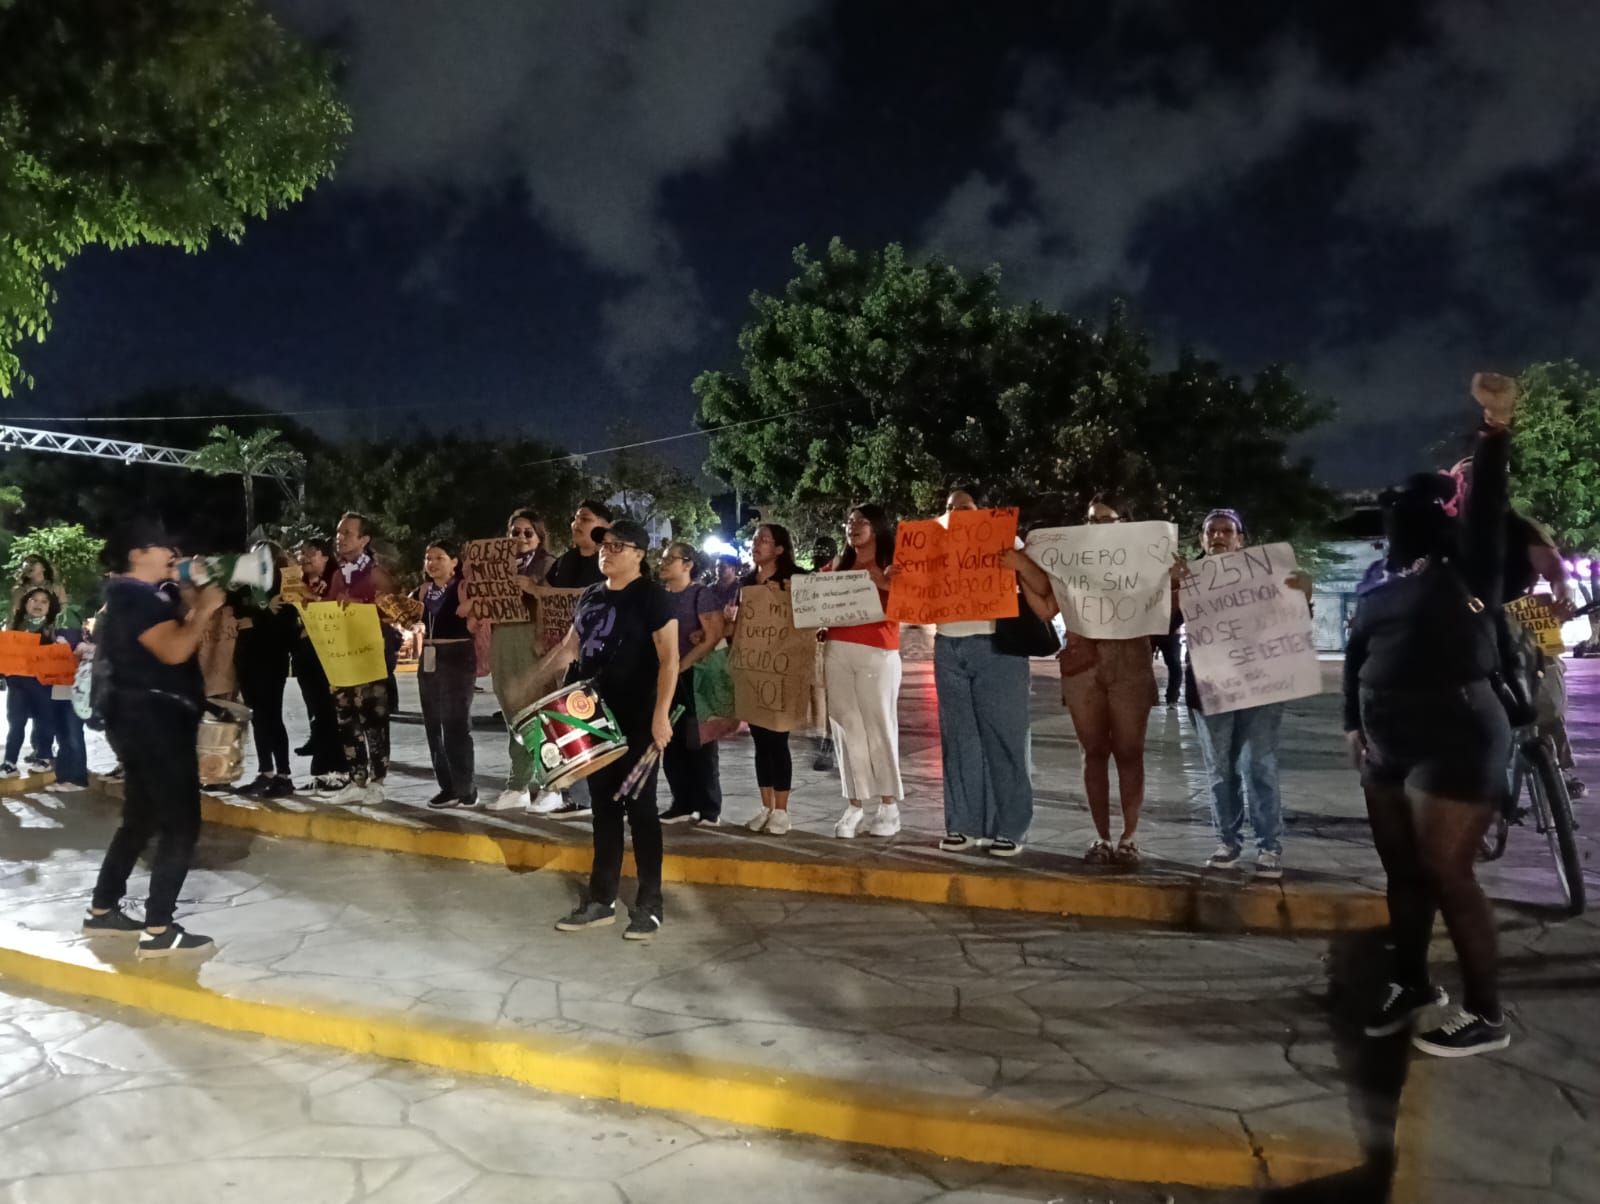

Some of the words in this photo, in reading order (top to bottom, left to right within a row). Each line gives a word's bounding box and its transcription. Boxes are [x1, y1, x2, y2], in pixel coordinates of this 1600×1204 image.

[494, 539, 517, 561] SER
[1041, 547, 1127, 571] QUIERO
[1101, 571, 1140, 592] SIN
[1180, 546, 1273, 596] #25N
[769, 602, 788, 619] mi
[1183, 602, 1208, 623] LA
[1208, 583, 1281, 613] VIOLENCIA
[1519, 597, 1537, 610] NO
[1186, 625, 1214, 650] NO
[1216, 618, 1243, 642] SE
[1228, 644, 1257, 667] SE
